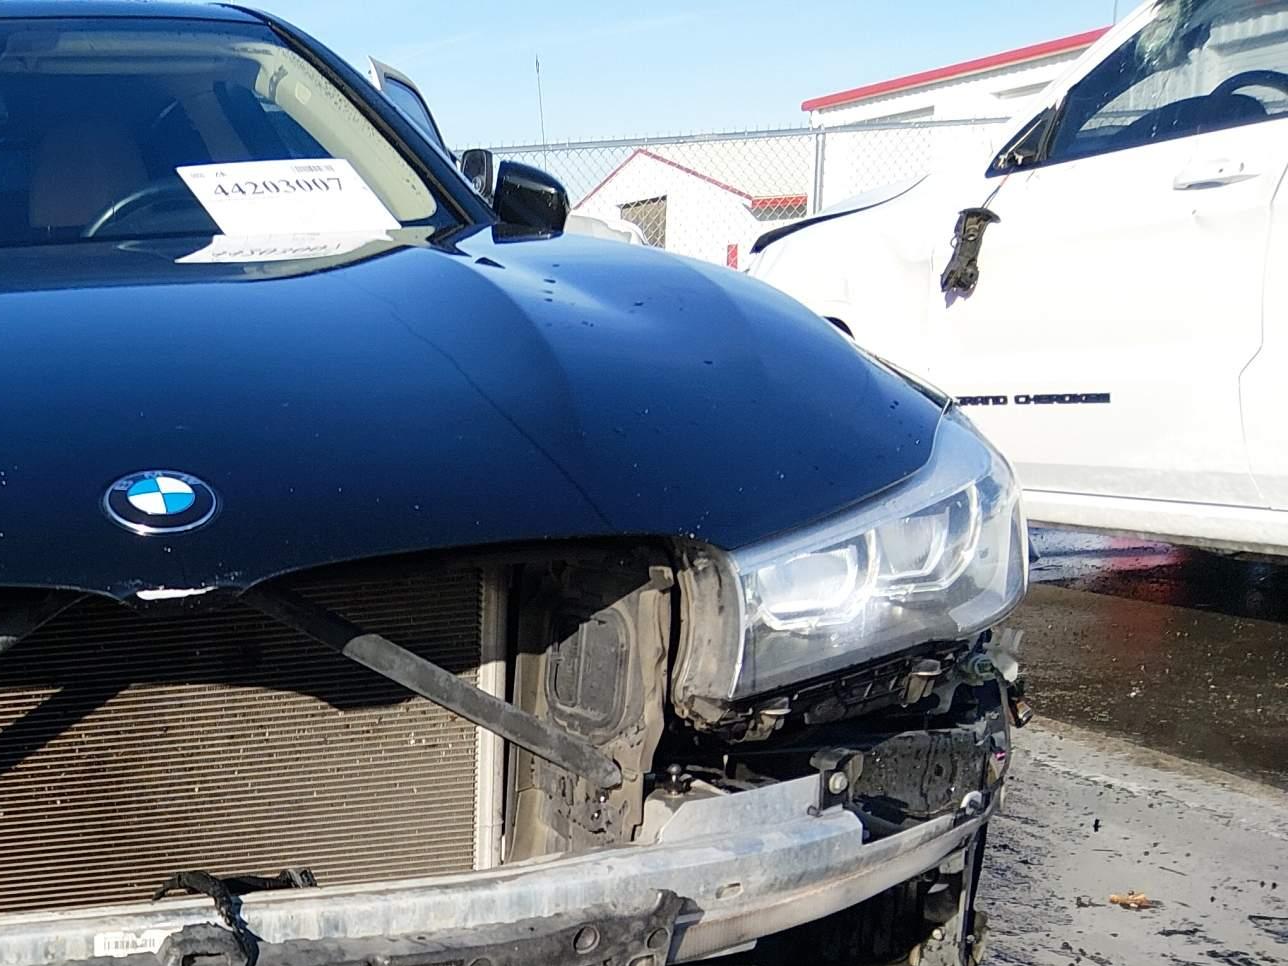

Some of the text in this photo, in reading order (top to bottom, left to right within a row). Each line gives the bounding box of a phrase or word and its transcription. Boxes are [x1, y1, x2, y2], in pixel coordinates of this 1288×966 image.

[213, 177, 343, 198] 44203007
[1014, 393, 1111, 405] CHEROKEE
[112, 470, 202, 491] BMW
